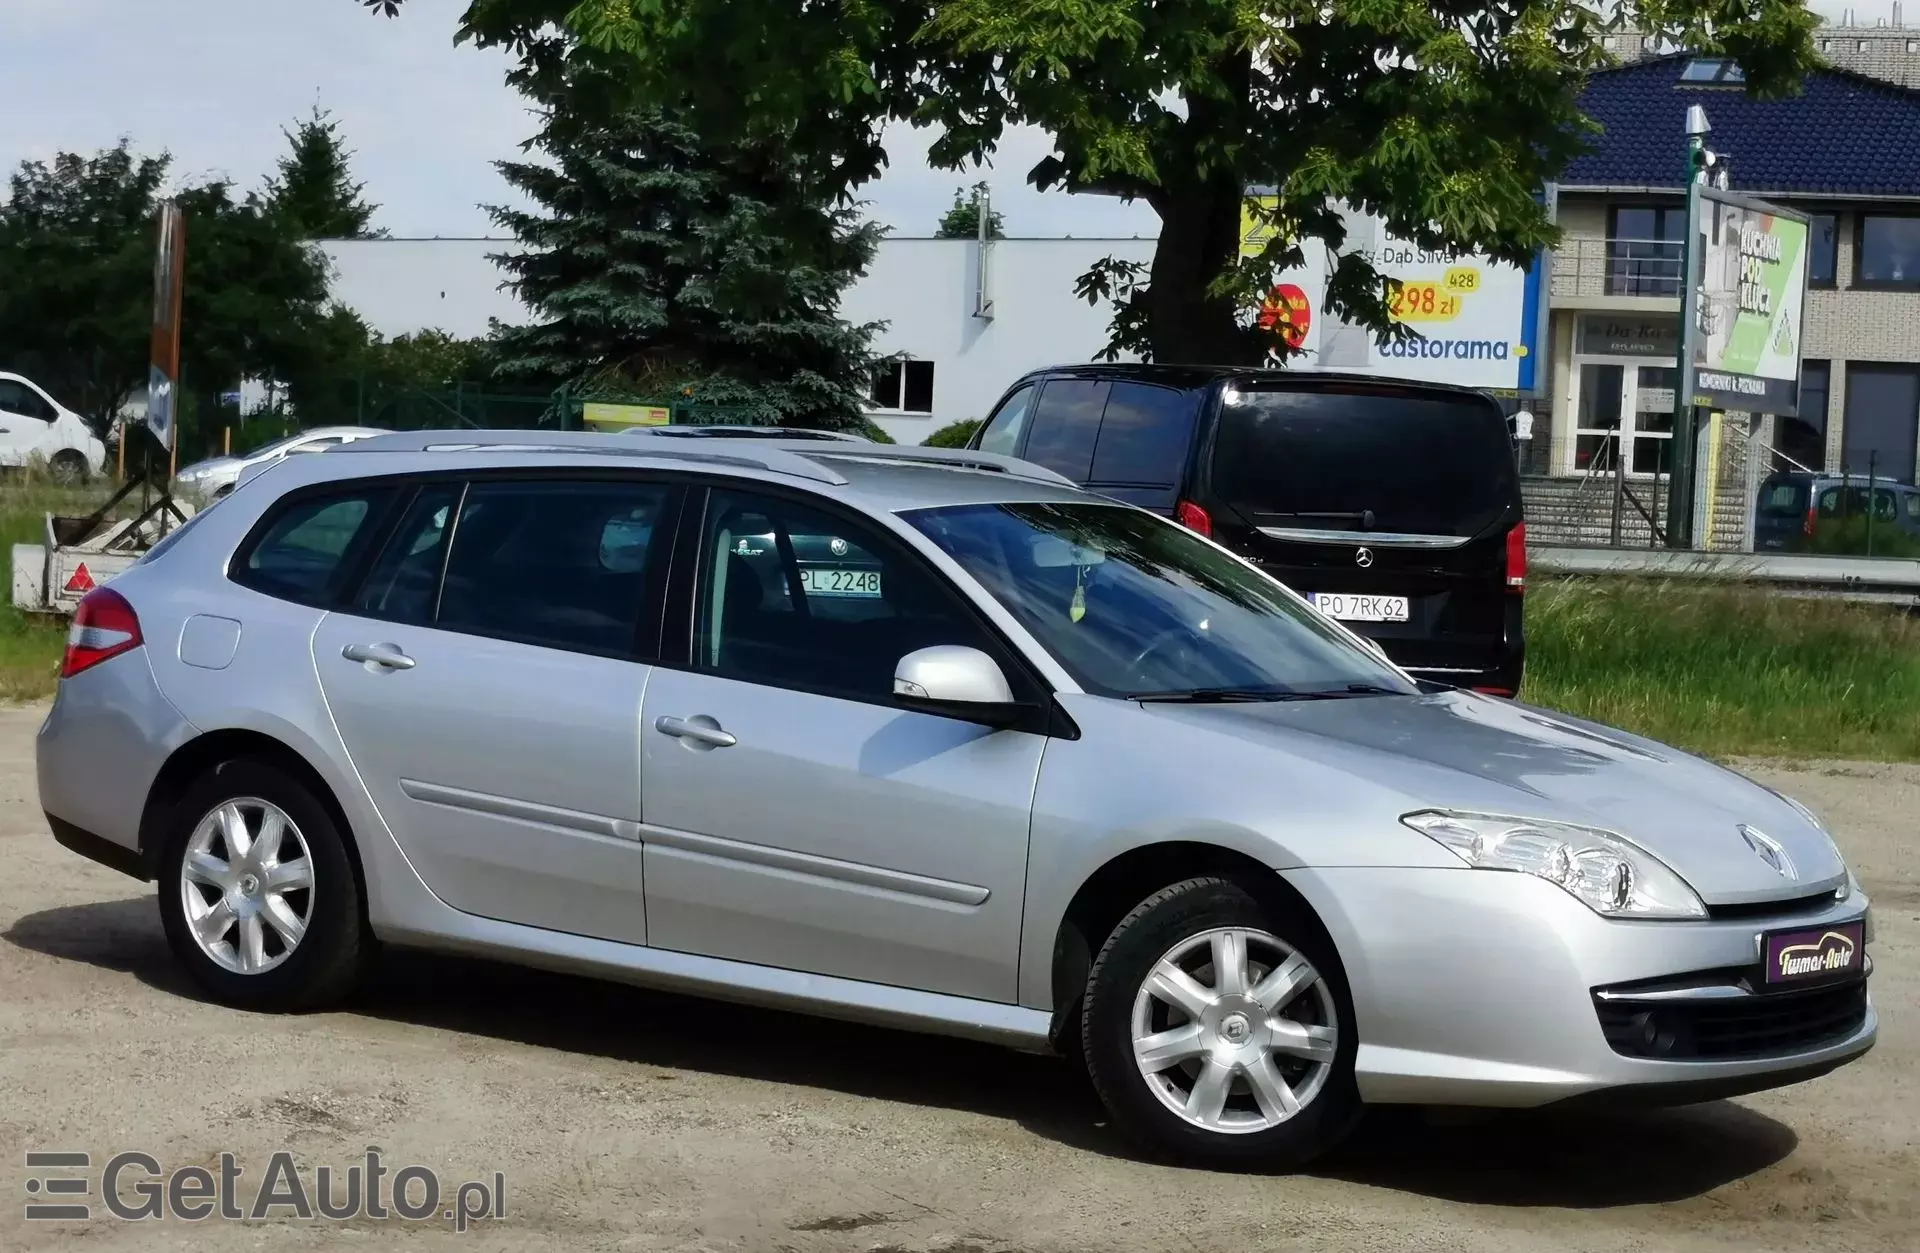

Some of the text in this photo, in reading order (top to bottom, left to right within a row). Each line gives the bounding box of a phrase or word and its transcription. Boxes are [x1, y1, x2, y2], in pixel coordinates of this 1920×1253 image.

[1449, 274, 1474, 288] 428
[1391, 287, 1435, 314] 298
[1379, 336, 1508, 361] castorama
[831, 571, 879, 592] 2248
[1320, 596, 1404, 617] PO 7RK62
